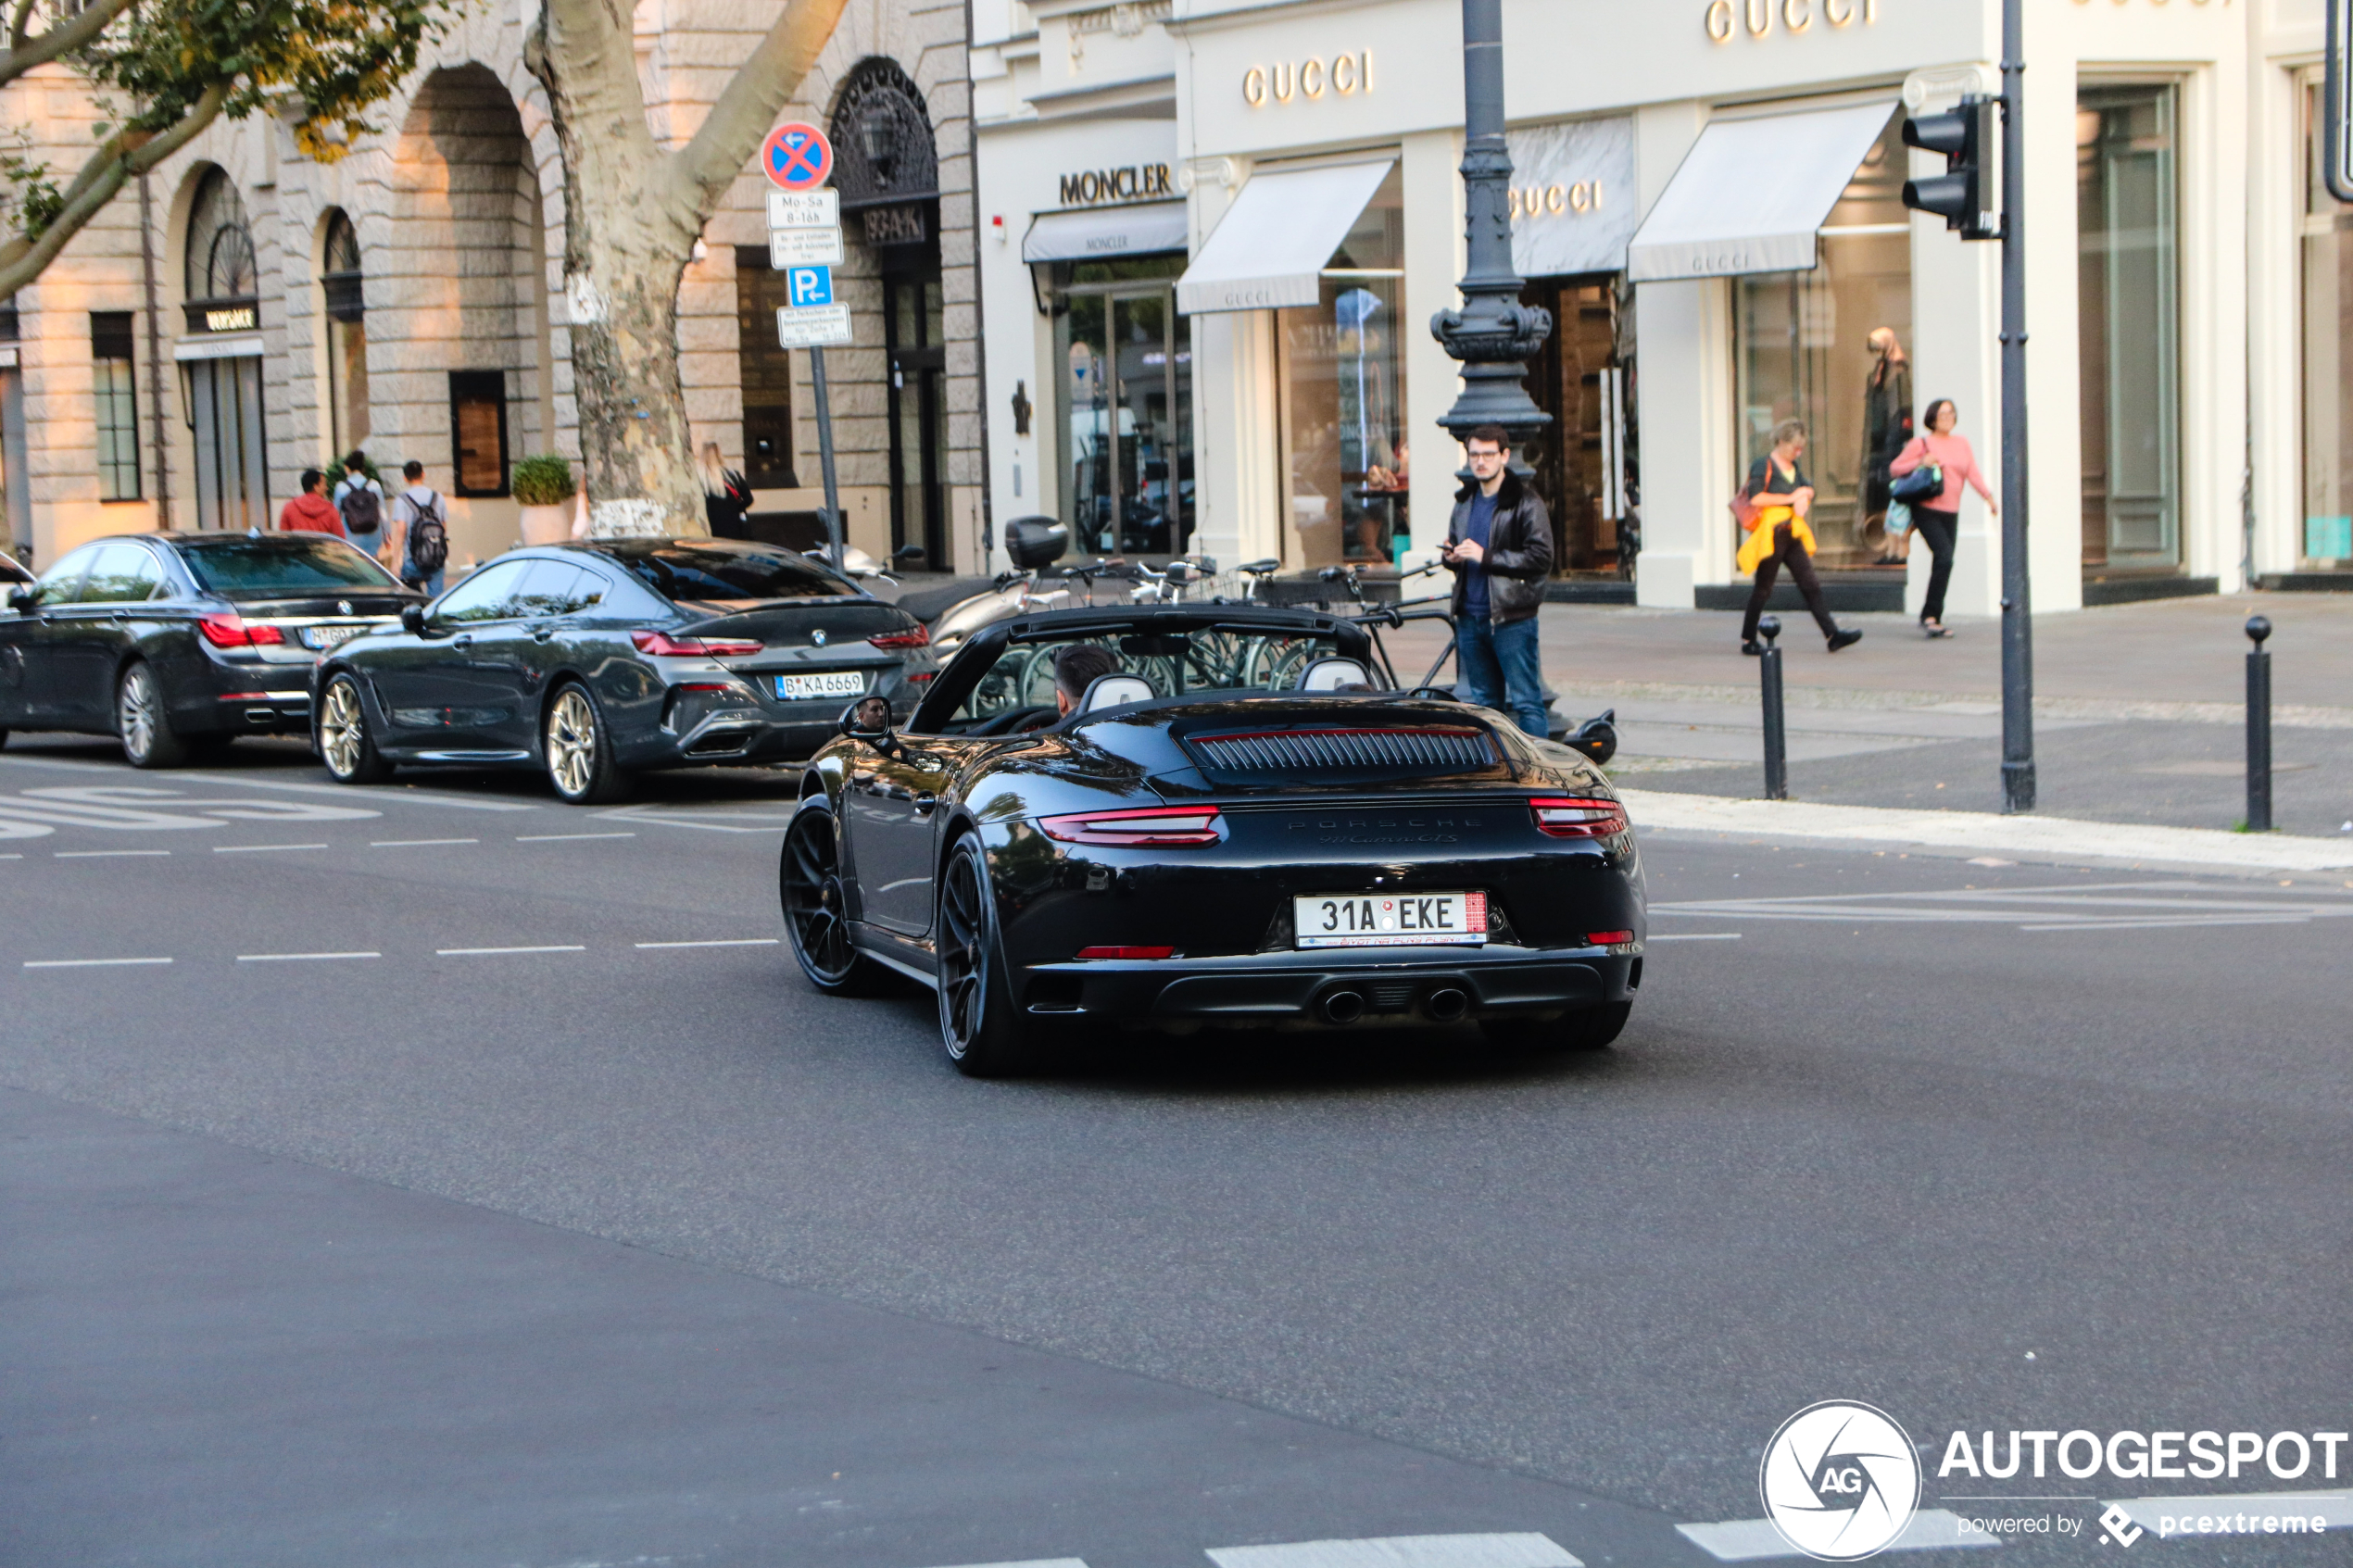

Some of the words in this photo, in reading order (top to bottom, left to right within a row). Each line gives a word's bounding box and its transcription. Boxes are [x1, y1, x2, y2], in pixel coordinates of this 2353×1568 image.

[1243, 50, 1373, 106] GUCCI
[1060, 162, 1174, 206] MONCLER
[783, 194, 823, 208] Mo-Sa
[786, 211, 820, 223] 8-16h
[1086, 234, 1127, 251] MONCLER
[1692, 252, 1748, 273] GUCCI
[794, 269, 819, 304] P
[1225, 290, 1270, 307] GUCCI
[786, 677, 795, 694] B
[804, 677, 824, 692] KA
[826, 674, 861, 691] 6669
[1289, 819, 1482, 830] PORSCHE
[1417, 834, 1458, 844] GTS
[1322, 900, 1377, 931] 31A
[1400, 898, 1453, 929] EKE
